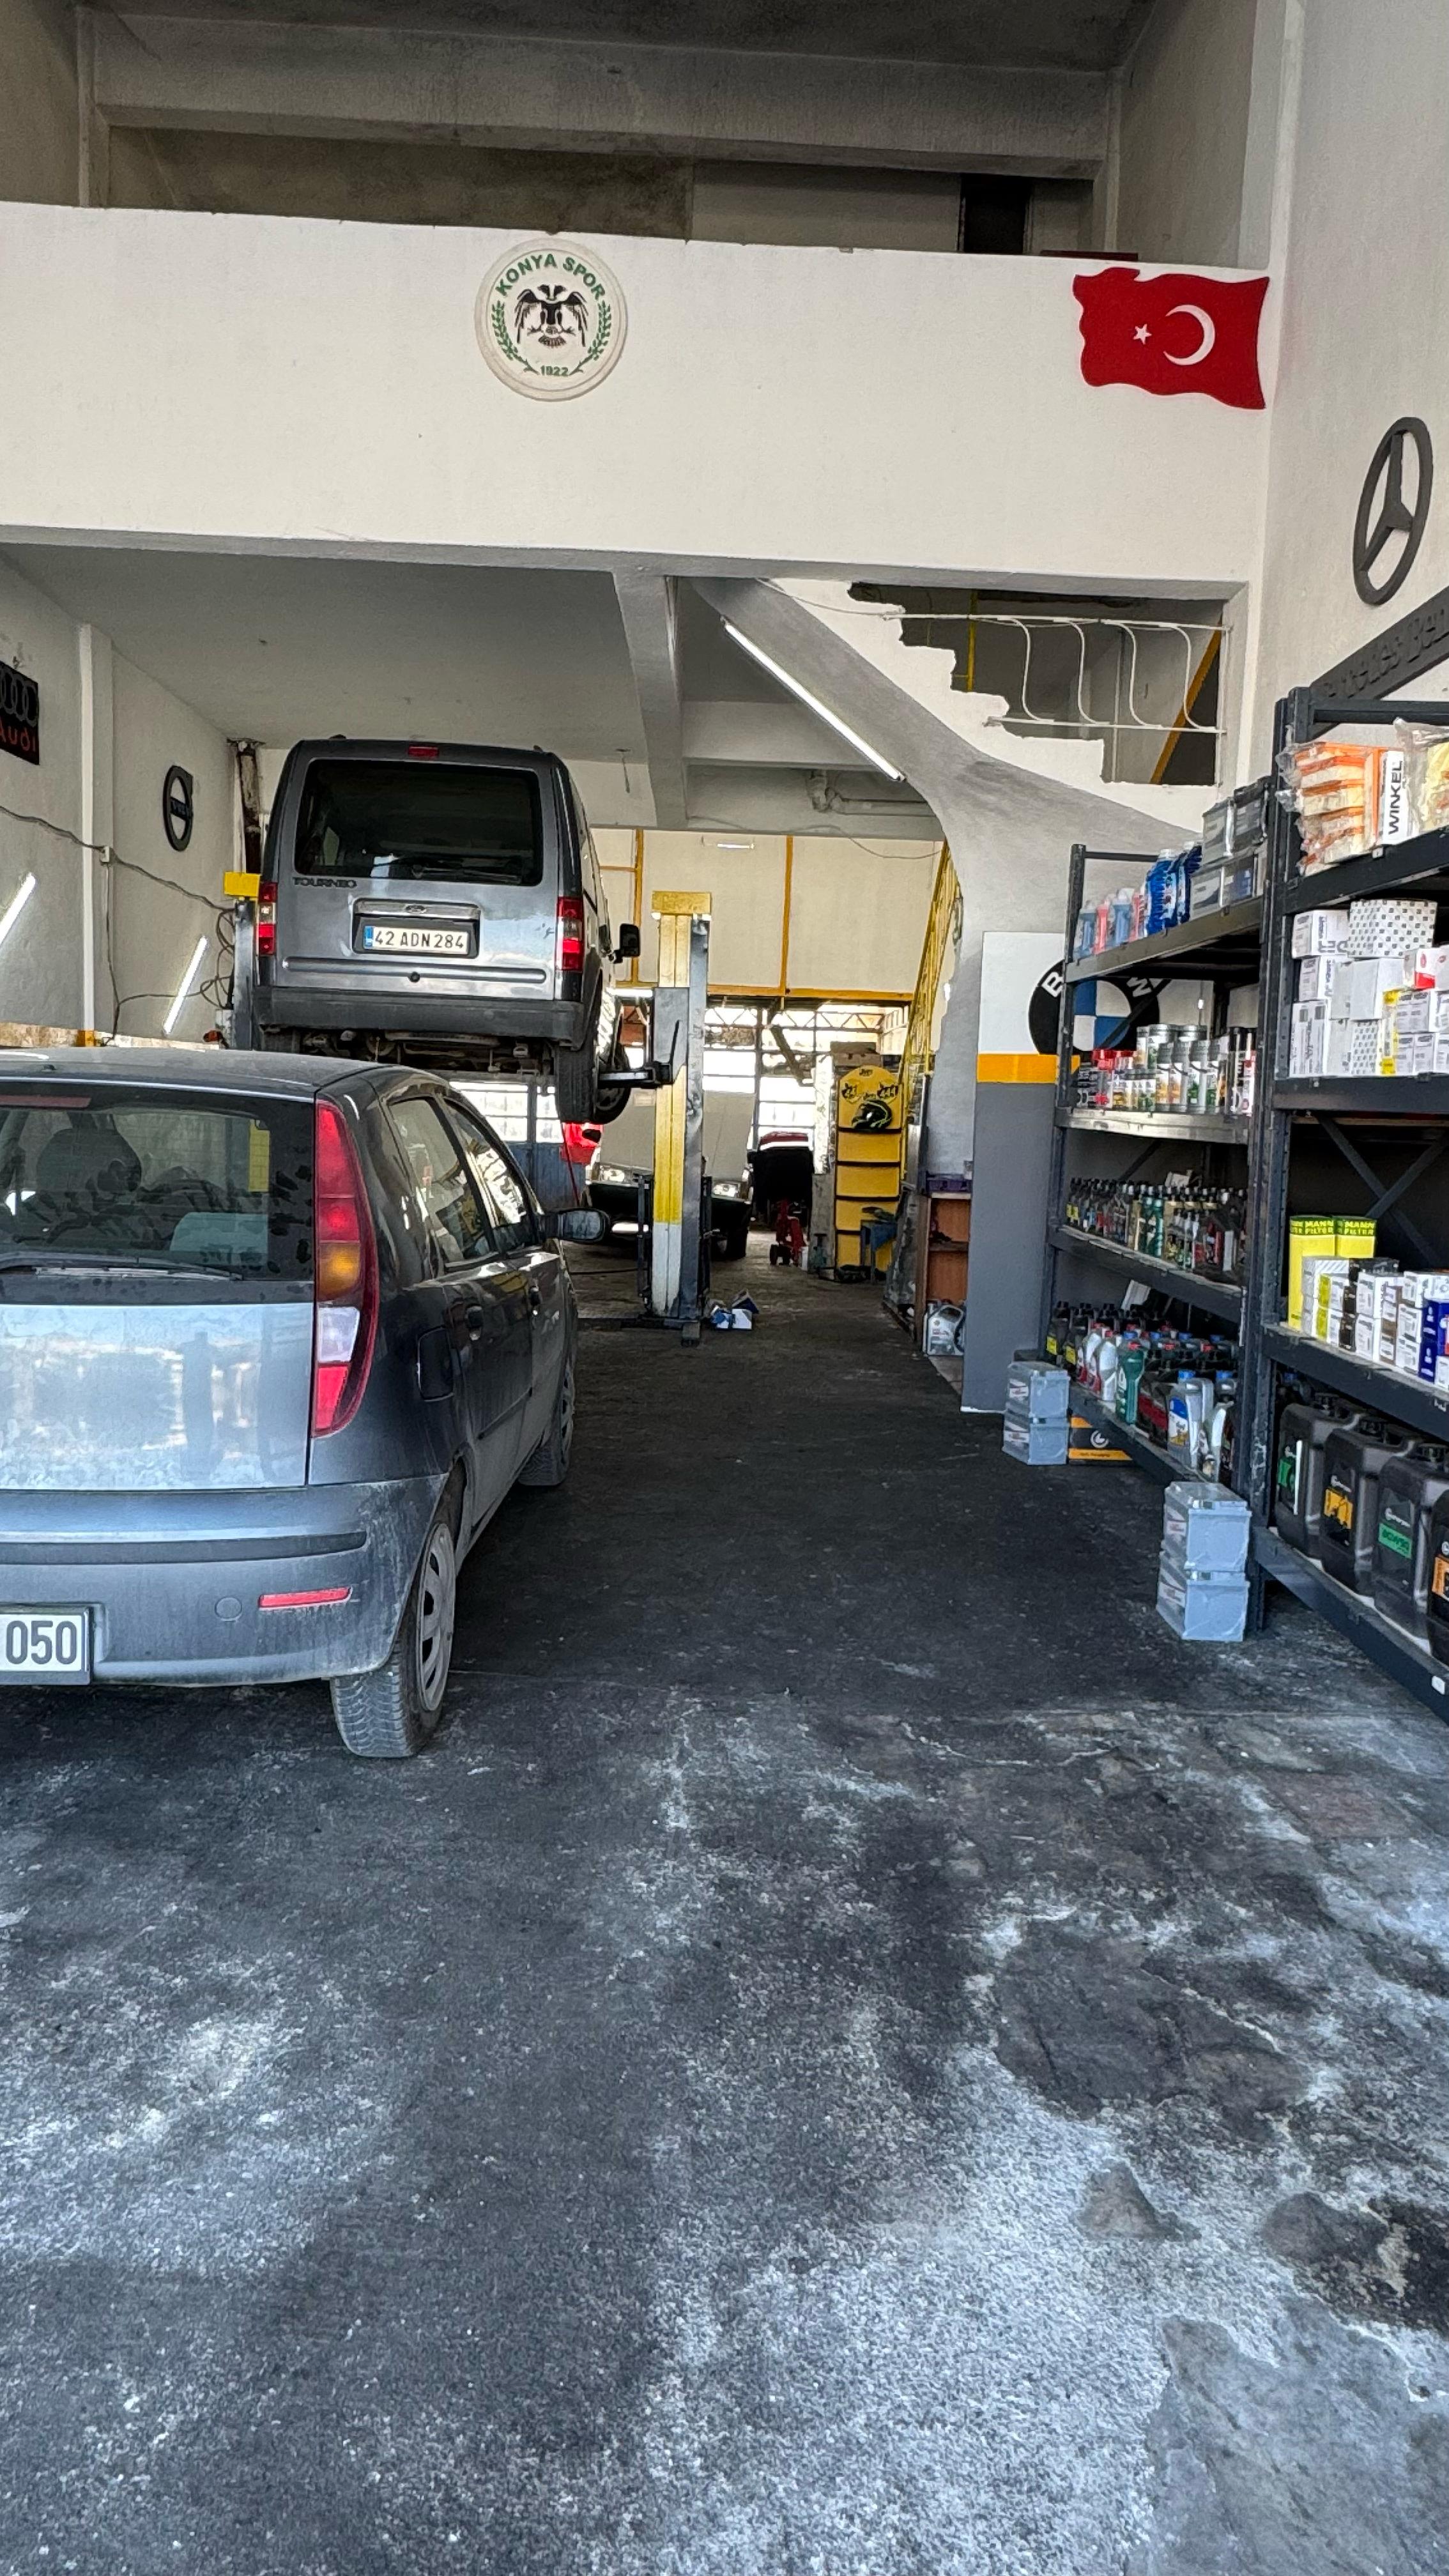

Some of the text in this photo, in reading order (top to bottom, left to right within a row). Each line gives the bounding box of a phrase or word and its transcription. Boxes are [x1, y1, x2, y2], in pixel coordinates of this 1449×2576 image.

[495, 254, 606, 300] KONYA SPOR
[540, 366, 569, 377] 1922
[1388, 760, 1402, 834] WINKEL
[375, 930, 464, 949] 42 ADN 284
[6, 1620, 78, 1665] 050
